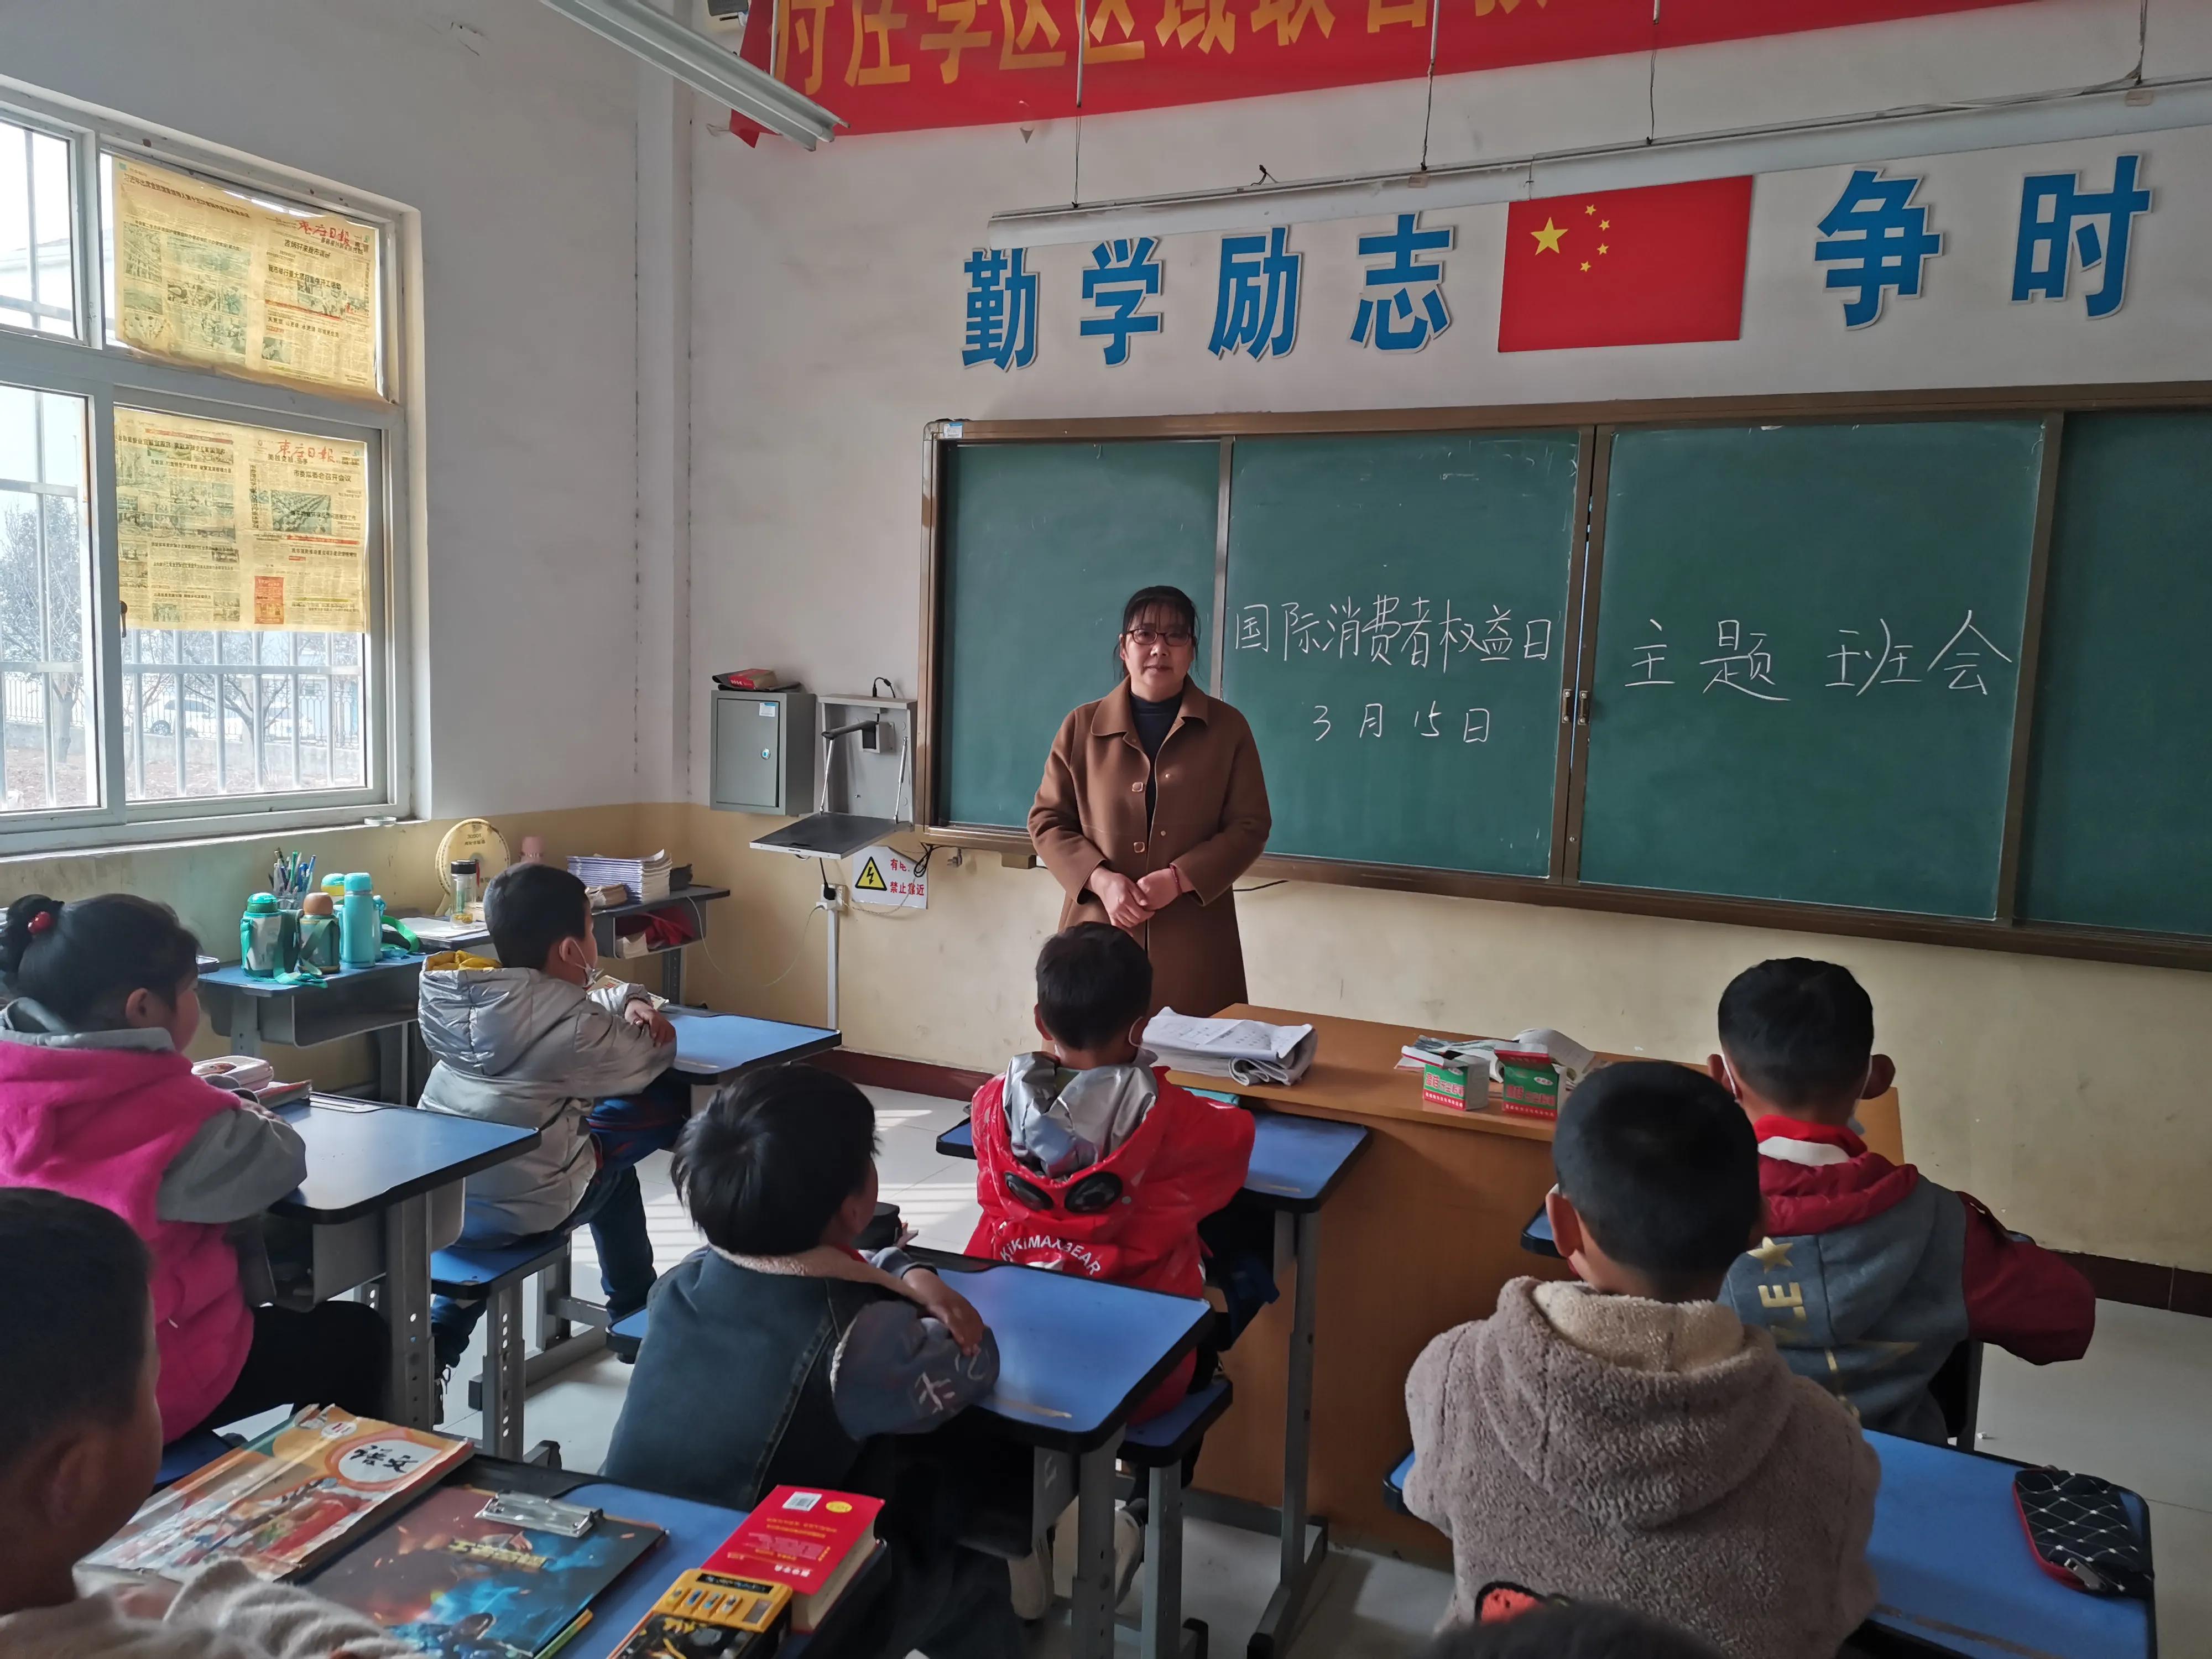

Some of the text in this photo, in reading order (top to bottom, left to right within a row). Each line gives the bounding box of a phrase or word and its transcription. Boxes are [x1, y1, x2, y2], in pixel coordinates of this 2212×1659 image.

[962, 154, 2151, 369] 勤学励志 争时
[1235, 594, 1552, 674] 国际消费者权益日
[1625, 609, 2013, 701] 主题班会
[890, 881, 925, 896] 禁止靠近
[349, 1444, 419, 1473] 语文
